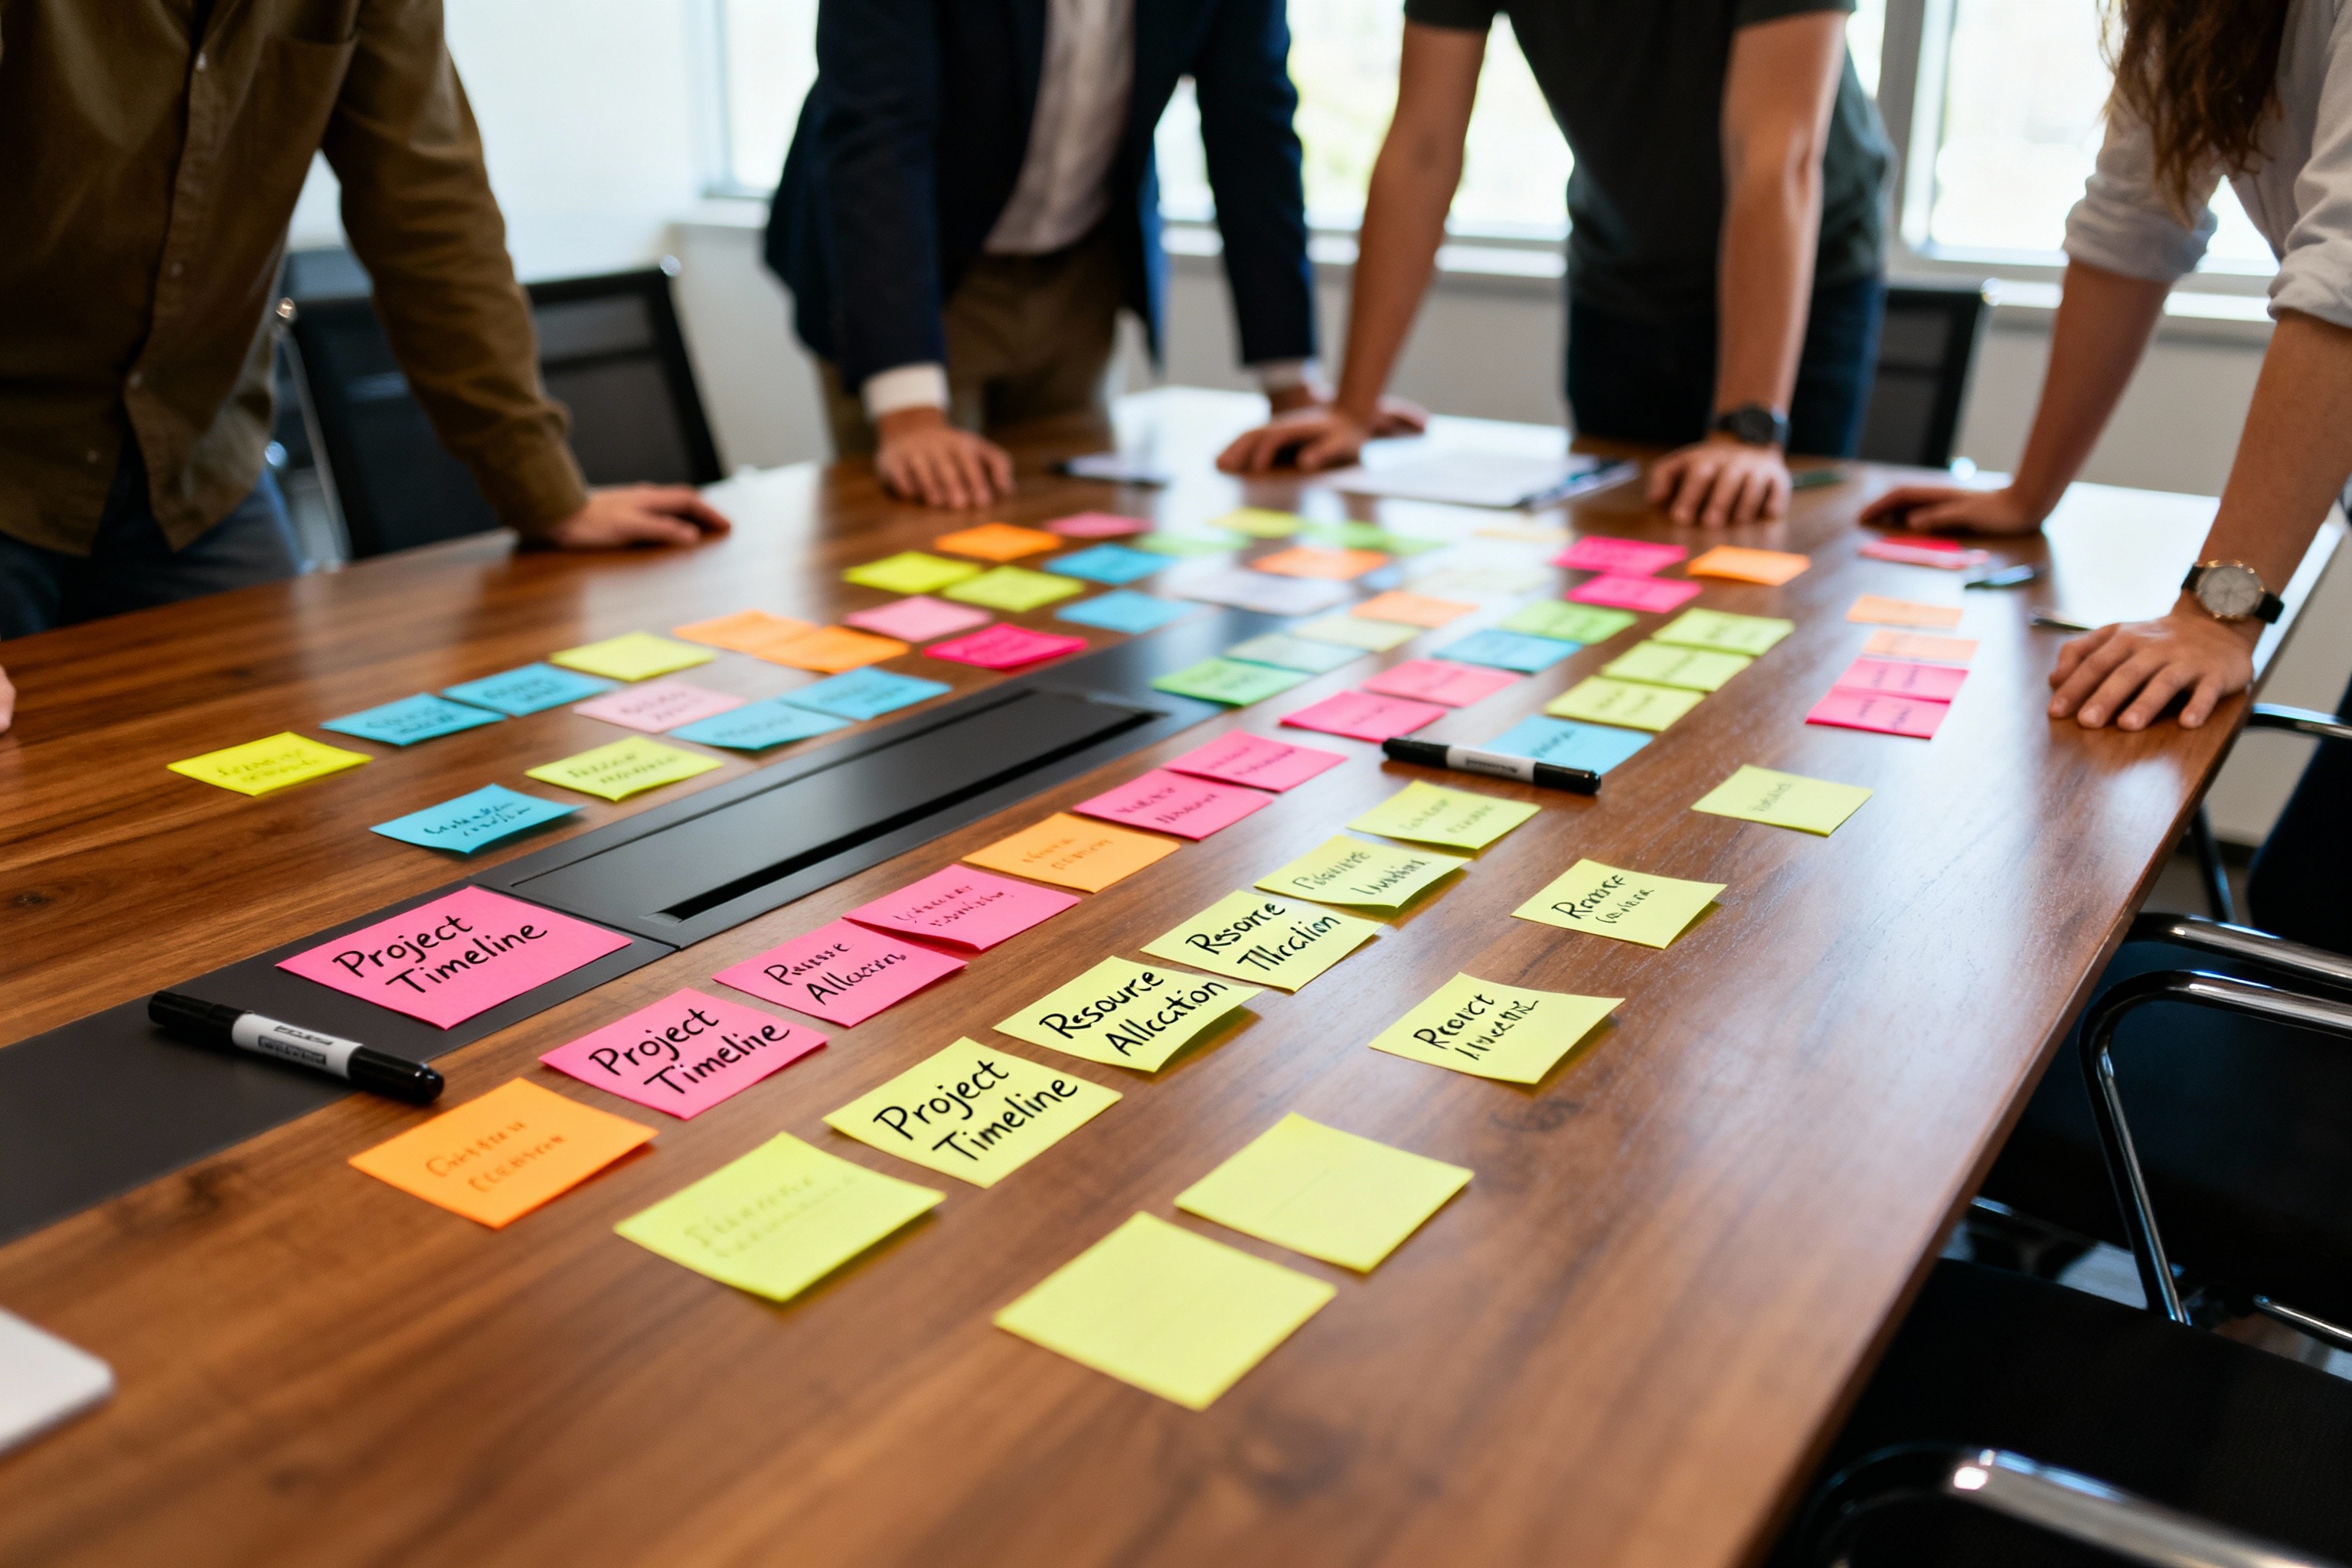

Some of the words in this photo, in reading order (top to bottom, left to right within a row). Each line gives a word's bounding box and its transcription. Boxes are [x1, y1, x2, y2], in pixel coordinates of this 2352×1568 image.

[332, 915, 473, 978] Project
[384, 924, 548, 994] Timeline
[588, 1008, 720, 1076] Project
[642, 1024, 790, 1095] Timeline
[872, 1060, 1010, 1142] Project
[931, 1079, 1078, 1161] Timeline
